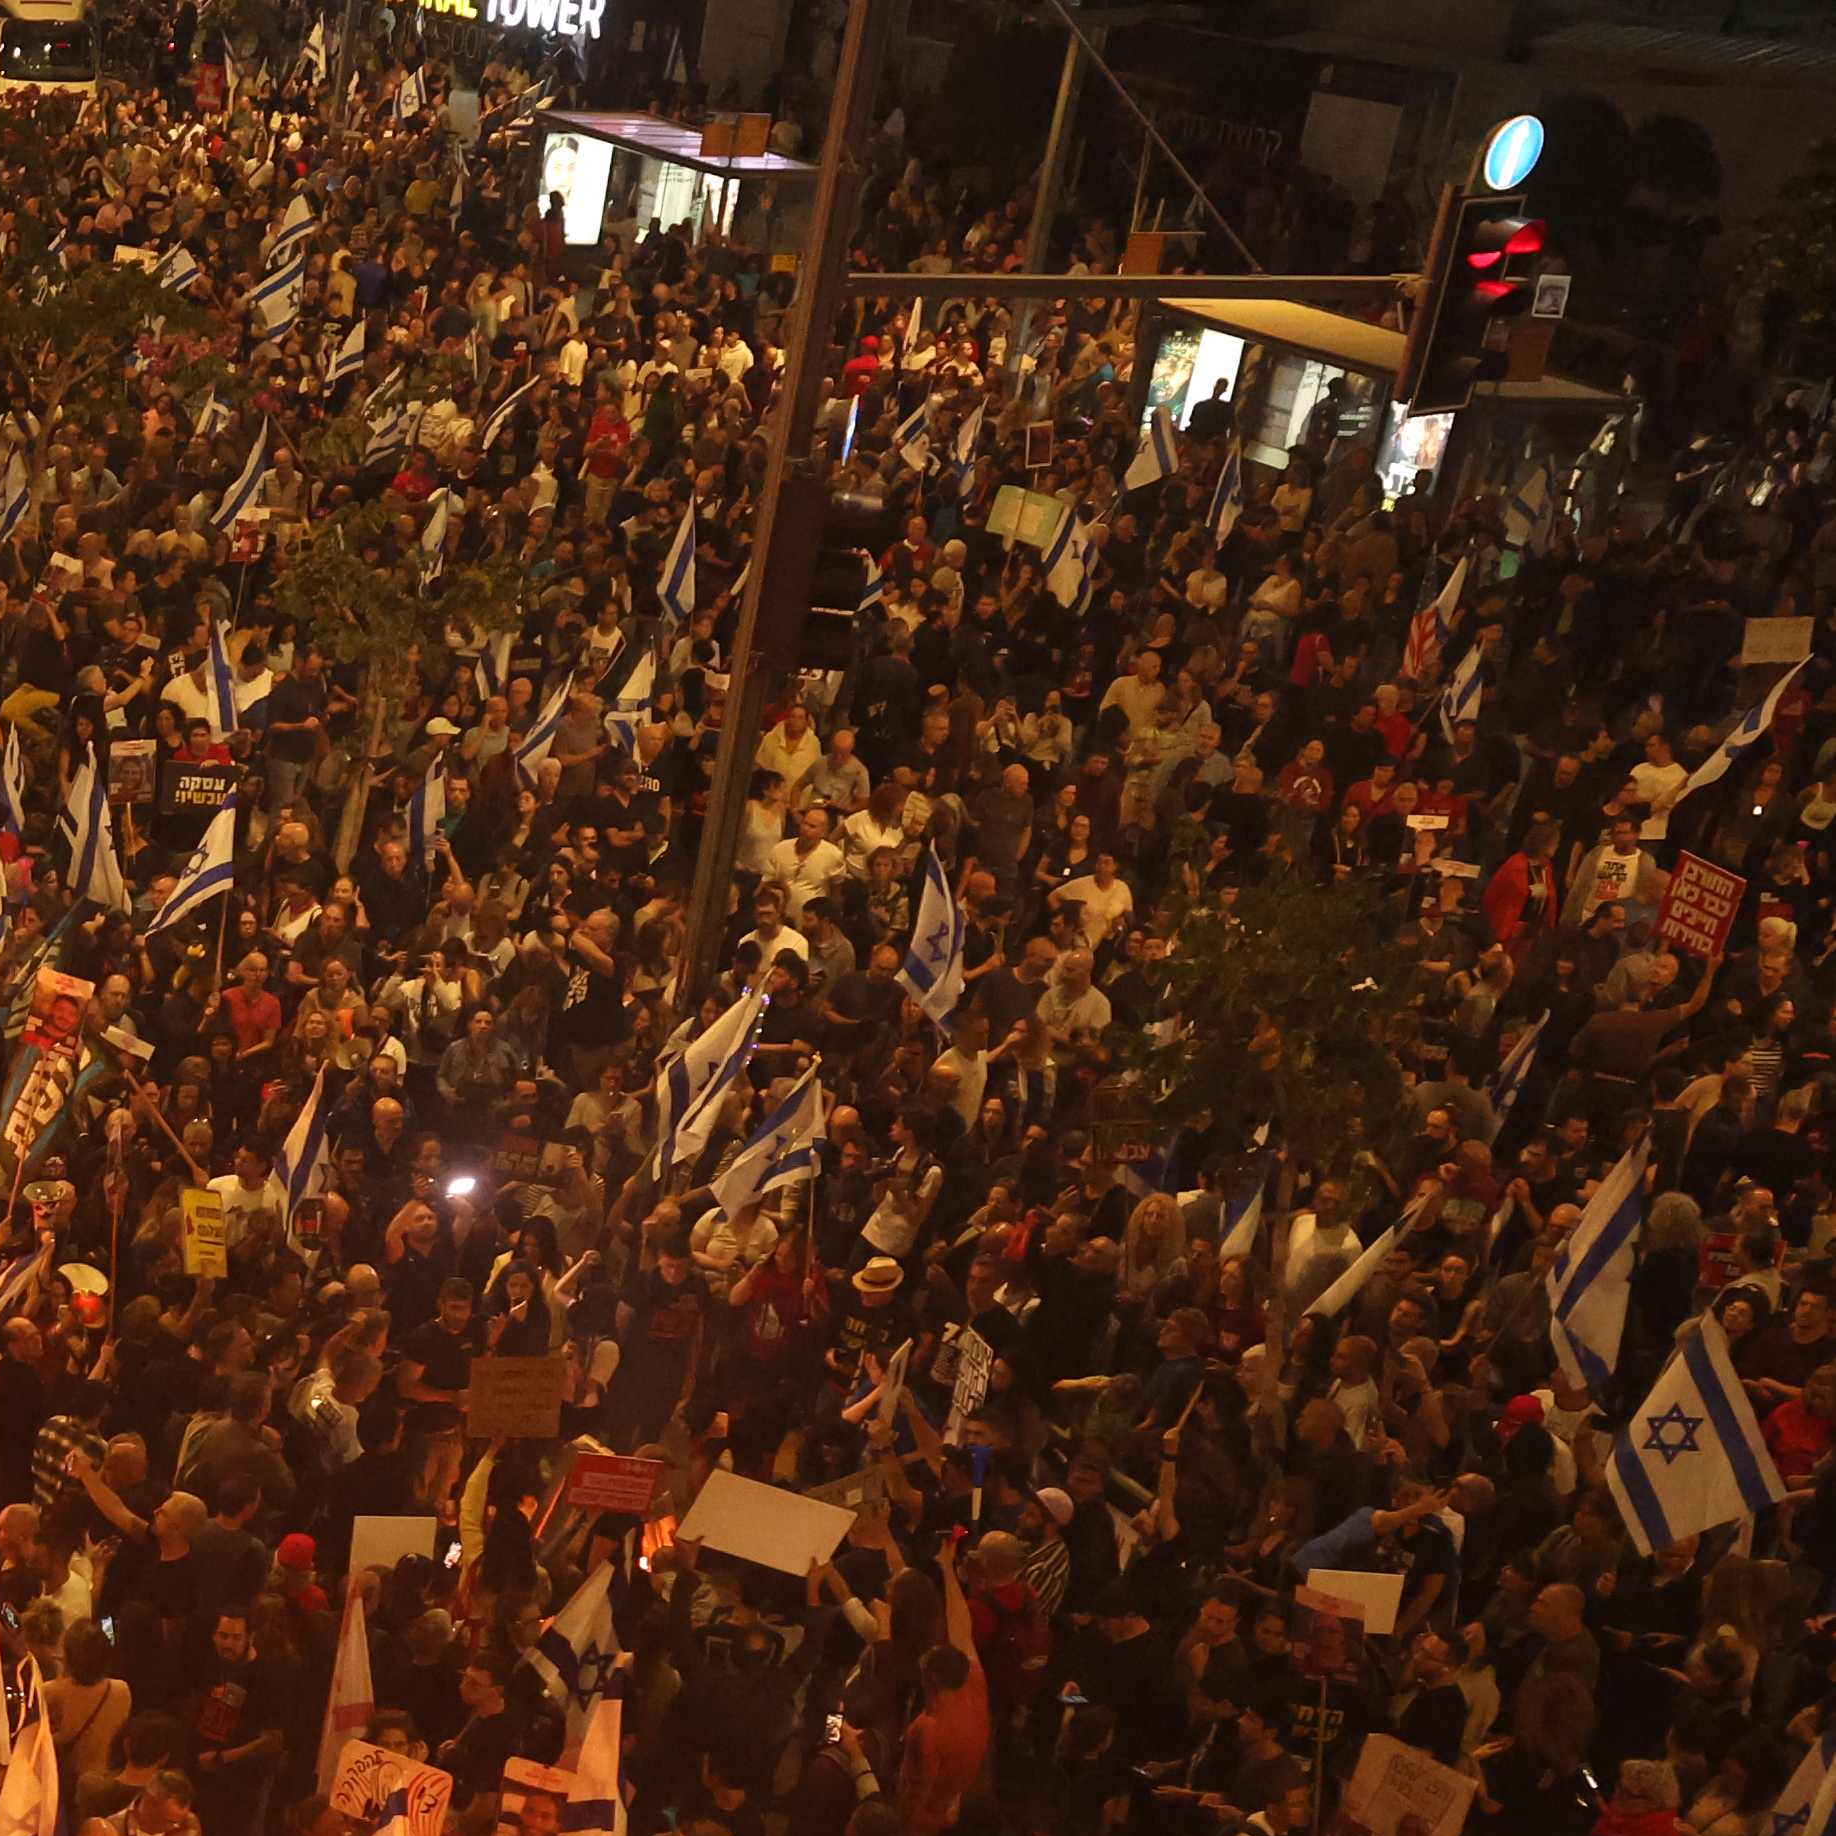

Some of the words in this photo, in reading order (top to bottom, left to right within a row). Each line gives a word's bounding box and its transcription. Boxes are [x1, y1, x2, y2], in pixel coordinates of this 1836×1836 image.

[486, 0, 606, 38] TOWER
[179, 776, 227, 790] עסקה
[175, 789, 227, 806] עכשיו!
[1661, 918, 1715, 955] בחירות
